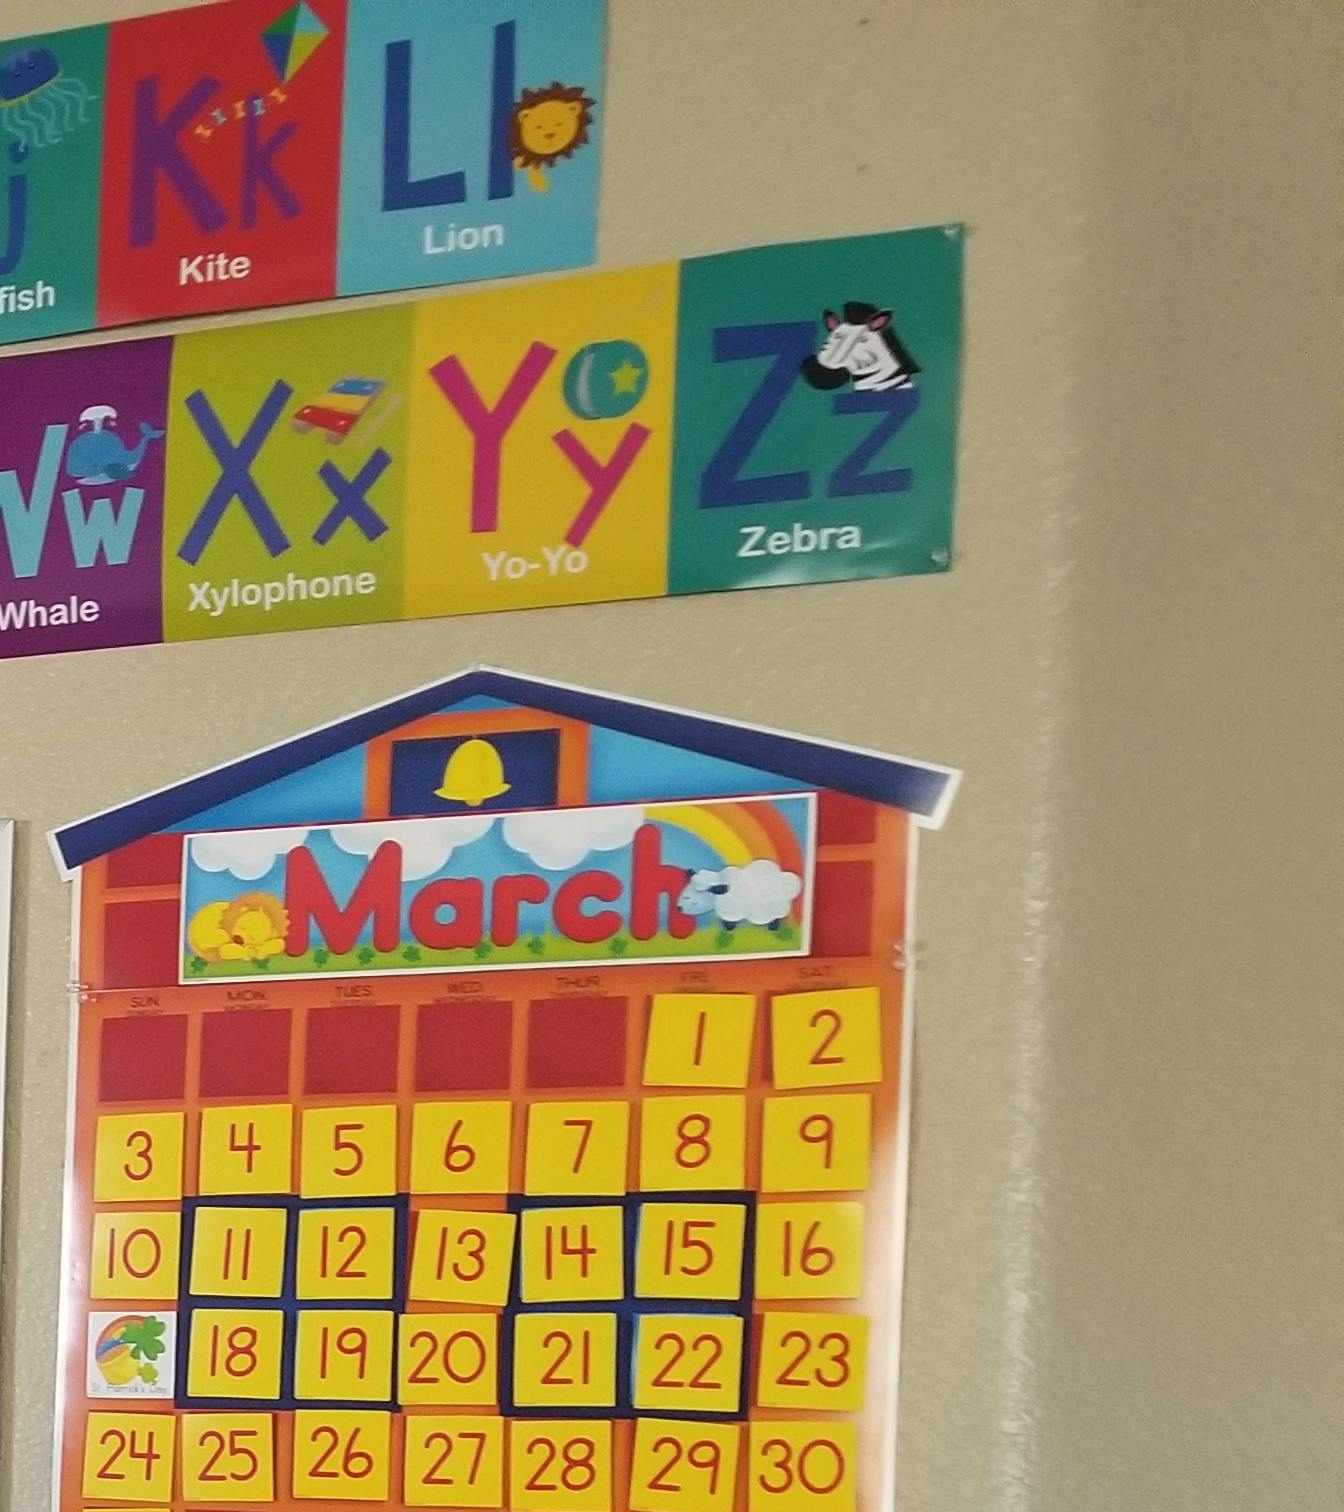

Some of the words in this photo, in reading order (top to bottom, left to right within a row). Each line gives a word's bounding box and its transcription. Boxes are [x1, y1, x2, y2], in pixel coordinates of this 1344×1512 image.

[422, 220, 503, 255] Lion
[179, 254, 250, 285] Kite
[428, 341, 652, 548] Yy
[481, 546, 588, 581] Yo-Yo
[738, 523, 861, 558] Zebra
[188, 569, 376, 614] Xylophone
[285, 823, 694, 956] March
[809, 1010, 843, 1065] 2
[124, 1131, 153, 1180] 3
[333, 1124, 364, 1176] 5
[564, 1120, 592, 1173] 7
[800, 1114, 833, 1169] 9
[106, 1227, 160, 1278] 10
[664, 1222, 713, 1275] 15
[408, 1333, 486, 1384] 20
[654, 1334, 722, 1388] 22
[99, 1429, 160, 1481] 24
[758, 1441, 844, 1495] 30
